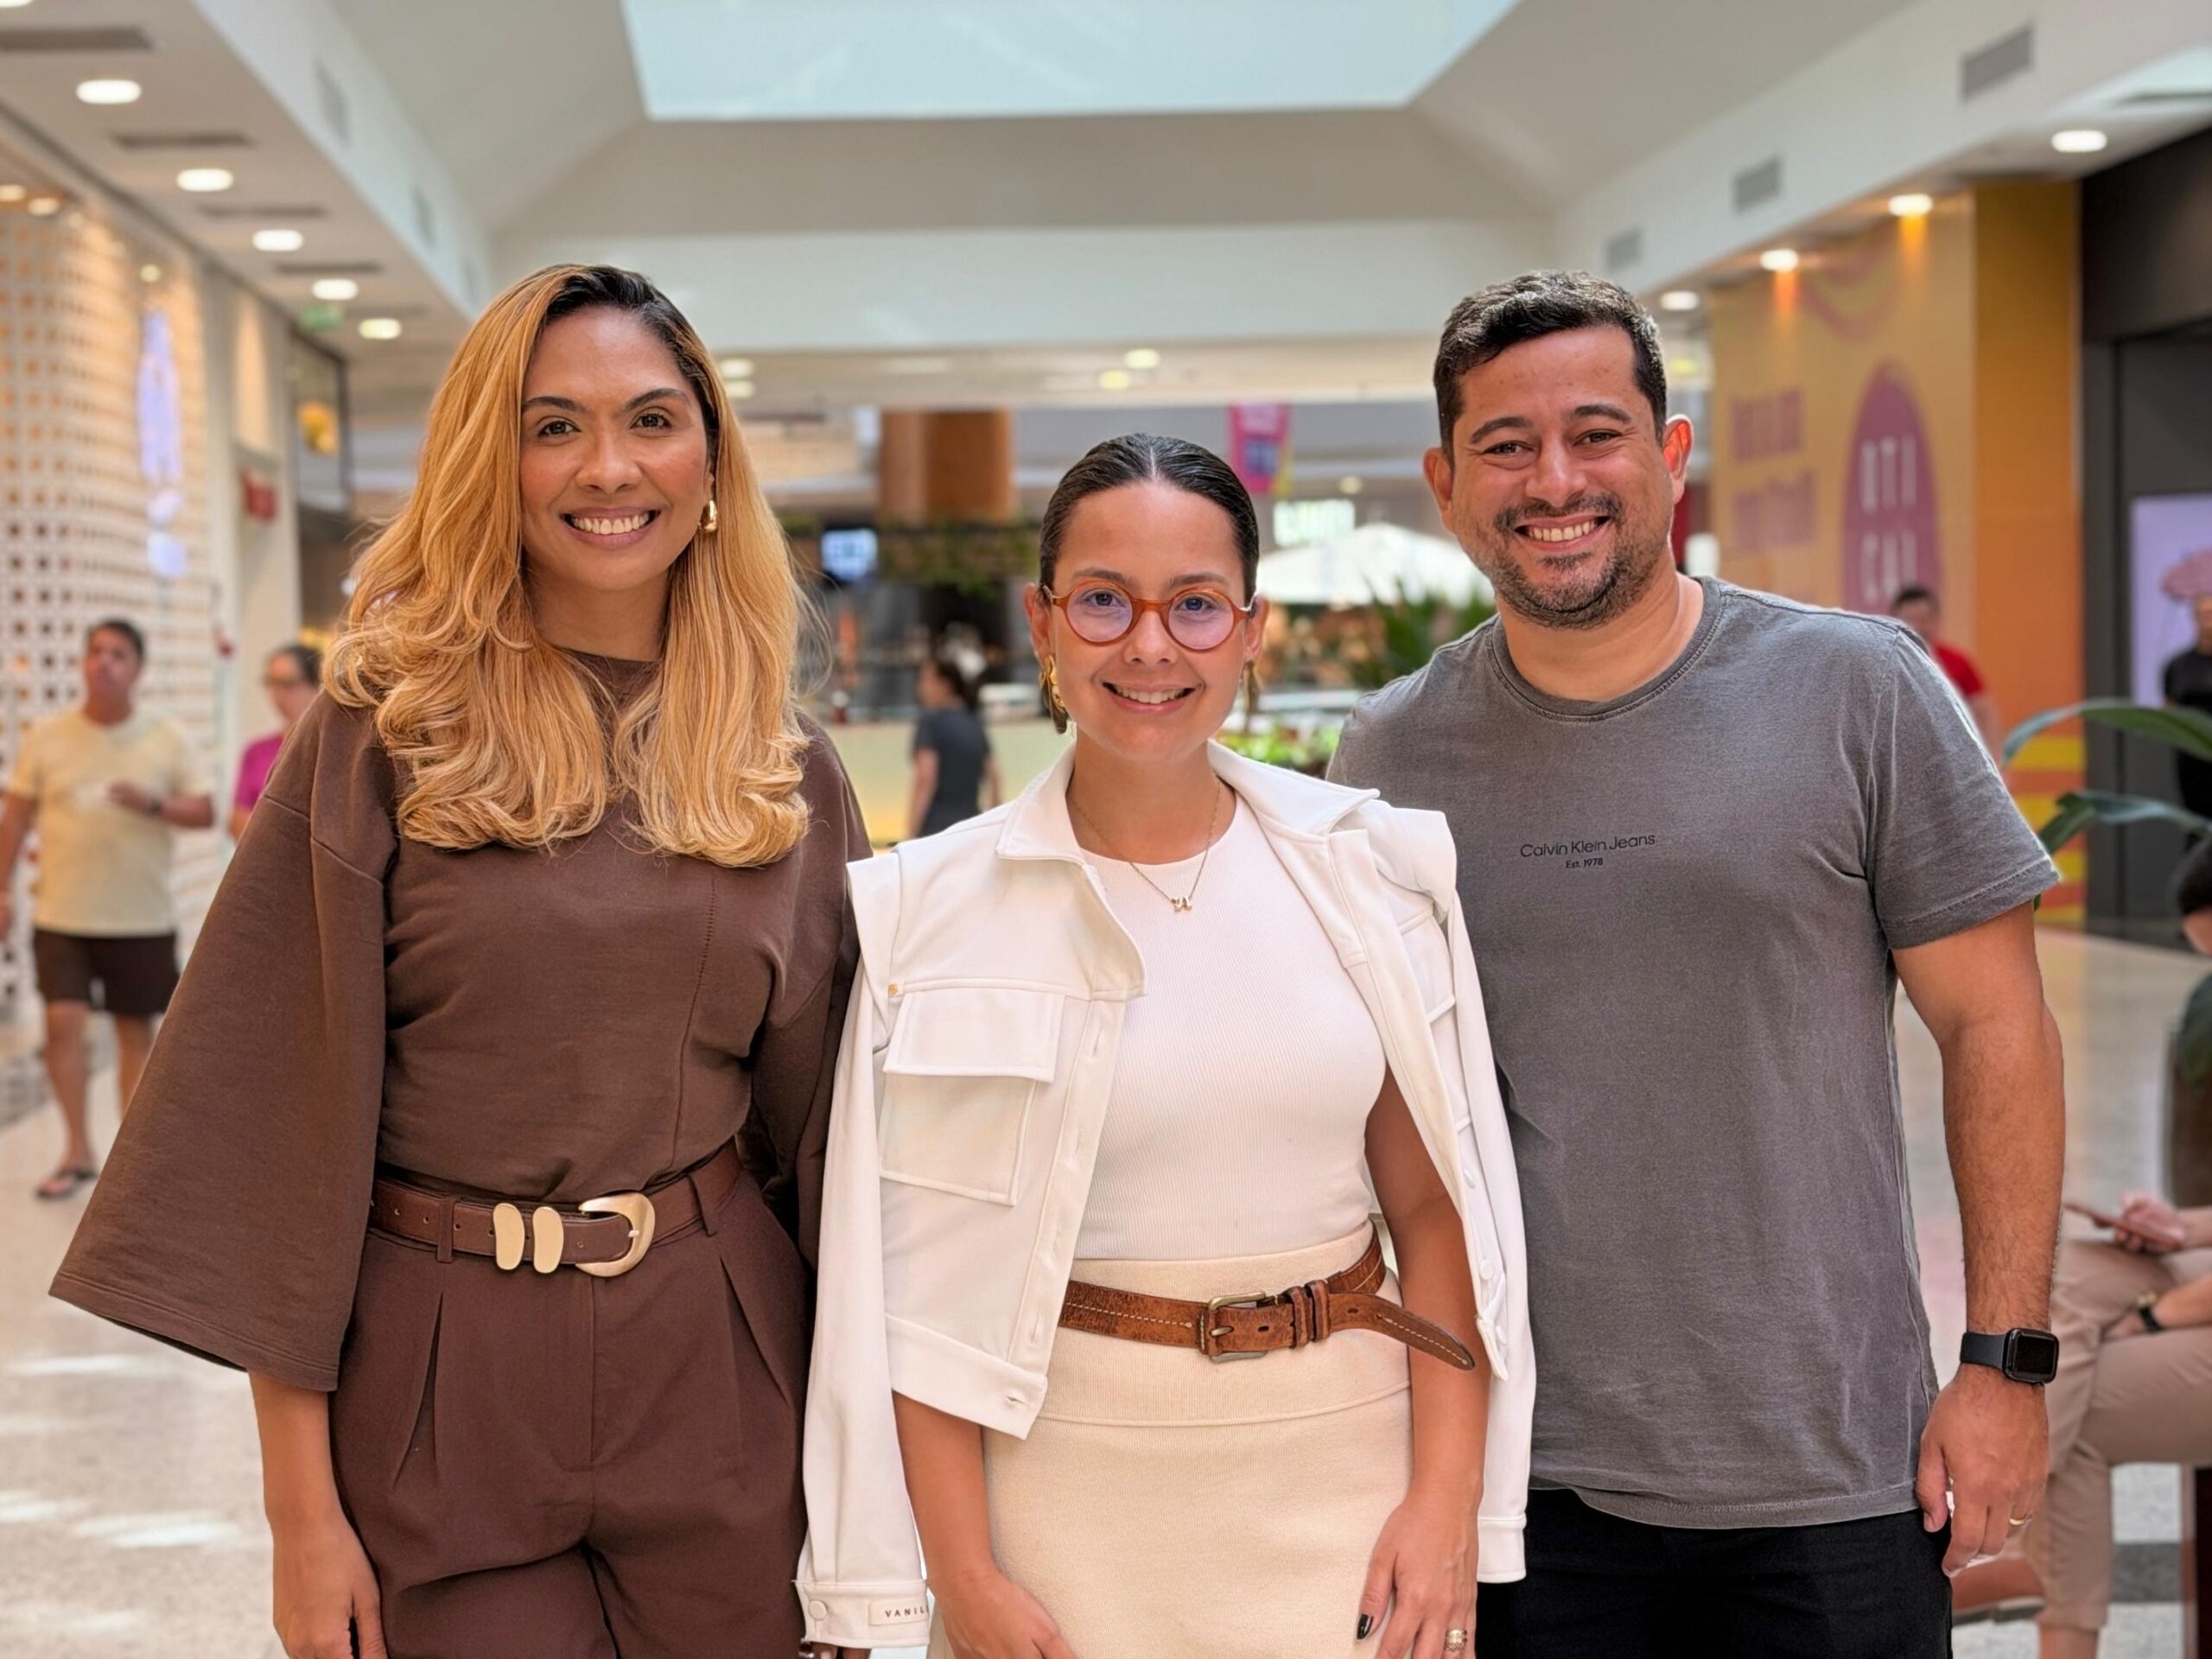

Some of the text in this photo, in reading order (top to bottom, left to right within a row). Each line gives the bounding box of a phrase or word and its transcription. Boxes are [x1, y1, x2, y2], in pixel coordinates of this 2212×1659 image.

[1520, 835, 1656, 858] Calvin Klein Jeans
[1584, 857, 1604, 867] 1978
[885, 1605, 929, 1618] VANIL
